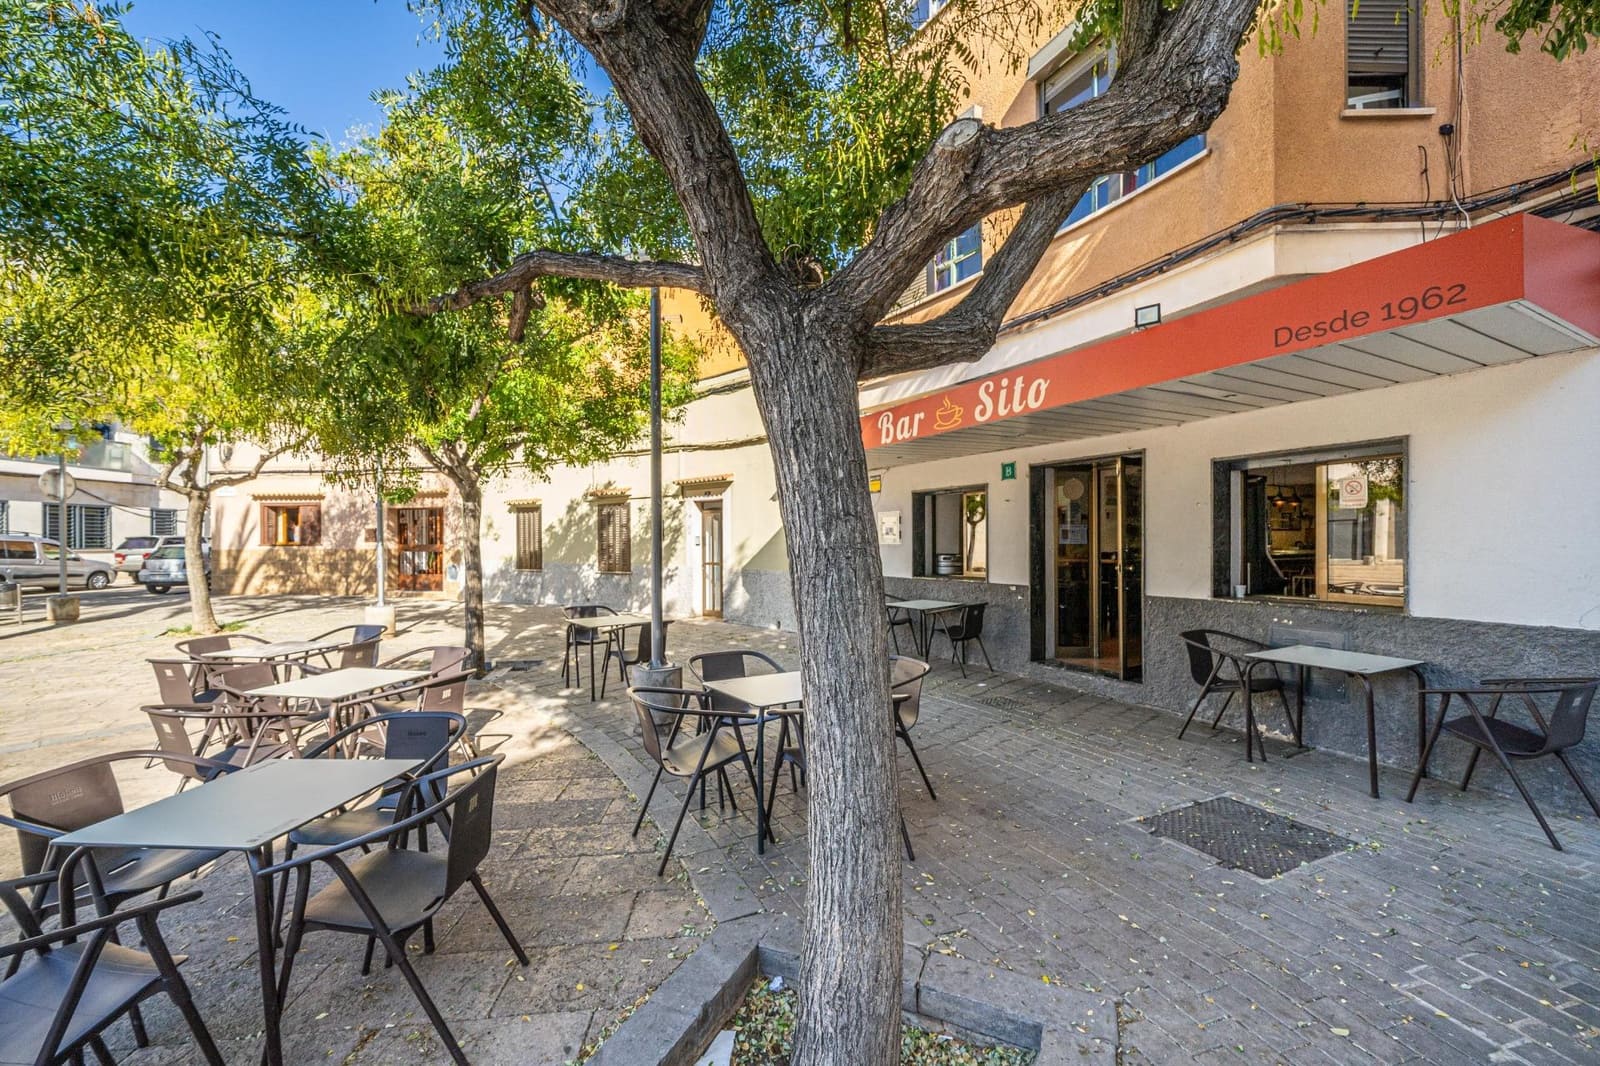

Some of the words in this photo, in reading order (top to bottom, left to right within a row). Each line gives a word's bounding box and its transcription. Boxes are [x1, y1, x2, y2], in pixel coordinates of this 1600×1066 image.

[1274, 309, 1370, 348] Desde
[1381, 283, 1468, 321] 1962
[878, 410, 925, 444] Bar
[974, 376, 1050, 422] Sito
